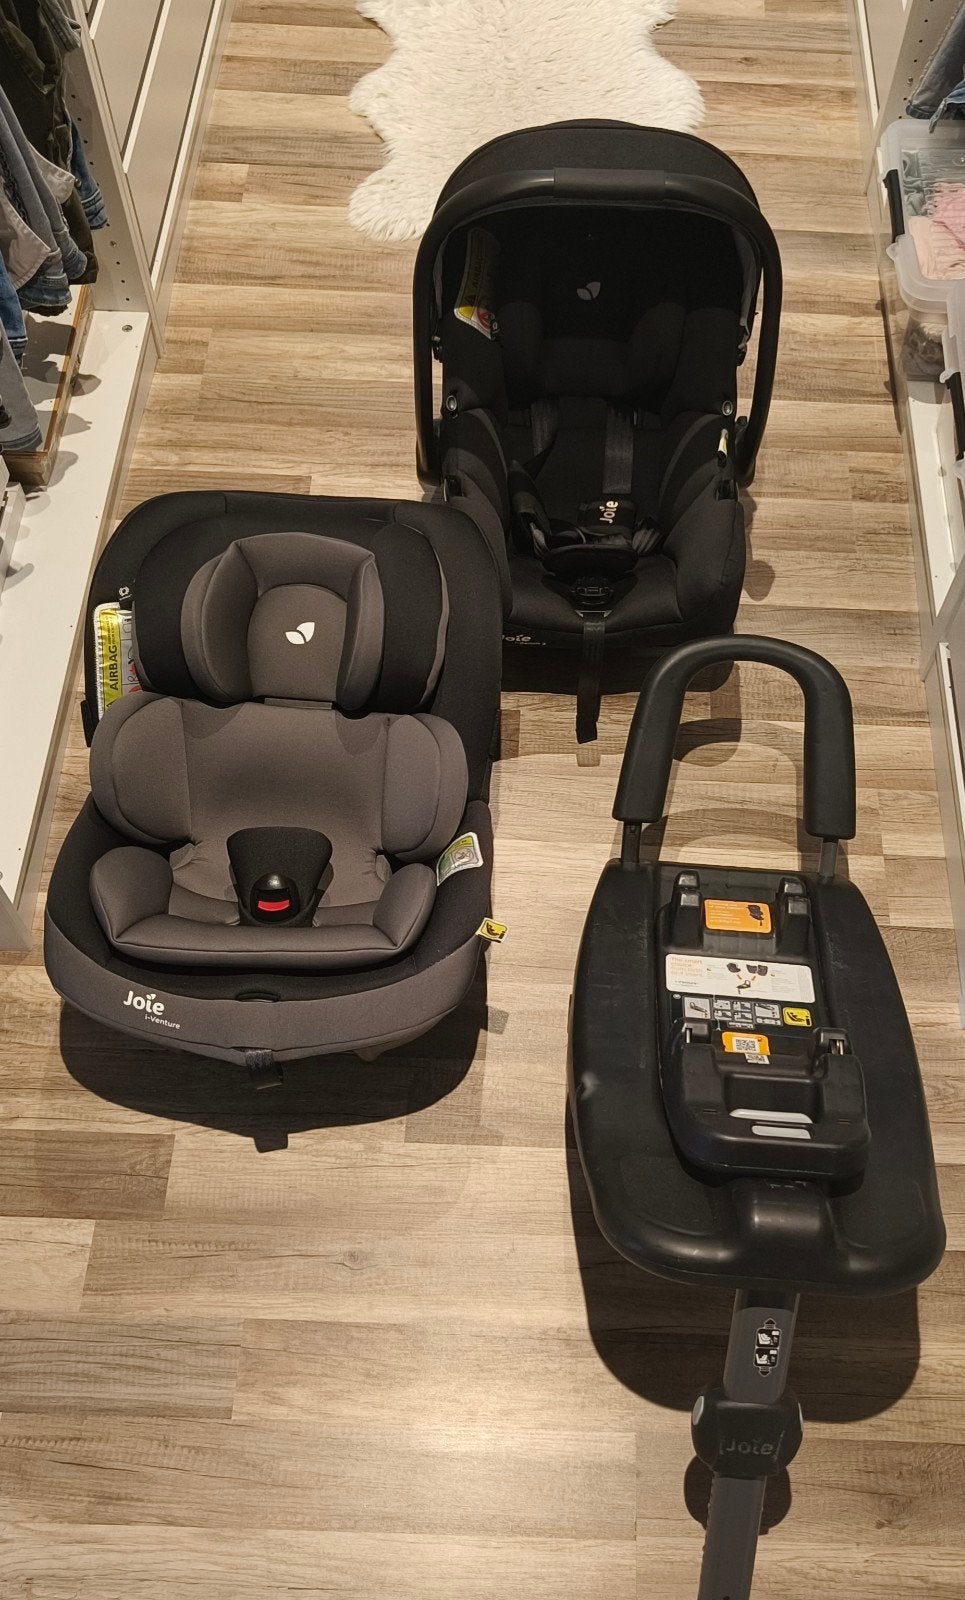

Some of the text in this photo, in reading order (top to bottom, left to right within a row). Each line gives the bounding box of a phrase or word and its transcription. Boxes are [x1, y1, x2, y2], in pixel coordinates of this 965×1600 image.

[599, 500, 618, 524] Joie
[108, 644, 119, 691] AIRBAG
[123, 990, 165, 1016] Joie
[144, 1013, 181, 1030] i-Venture
[725, 1437, 774, 1455] Joie
